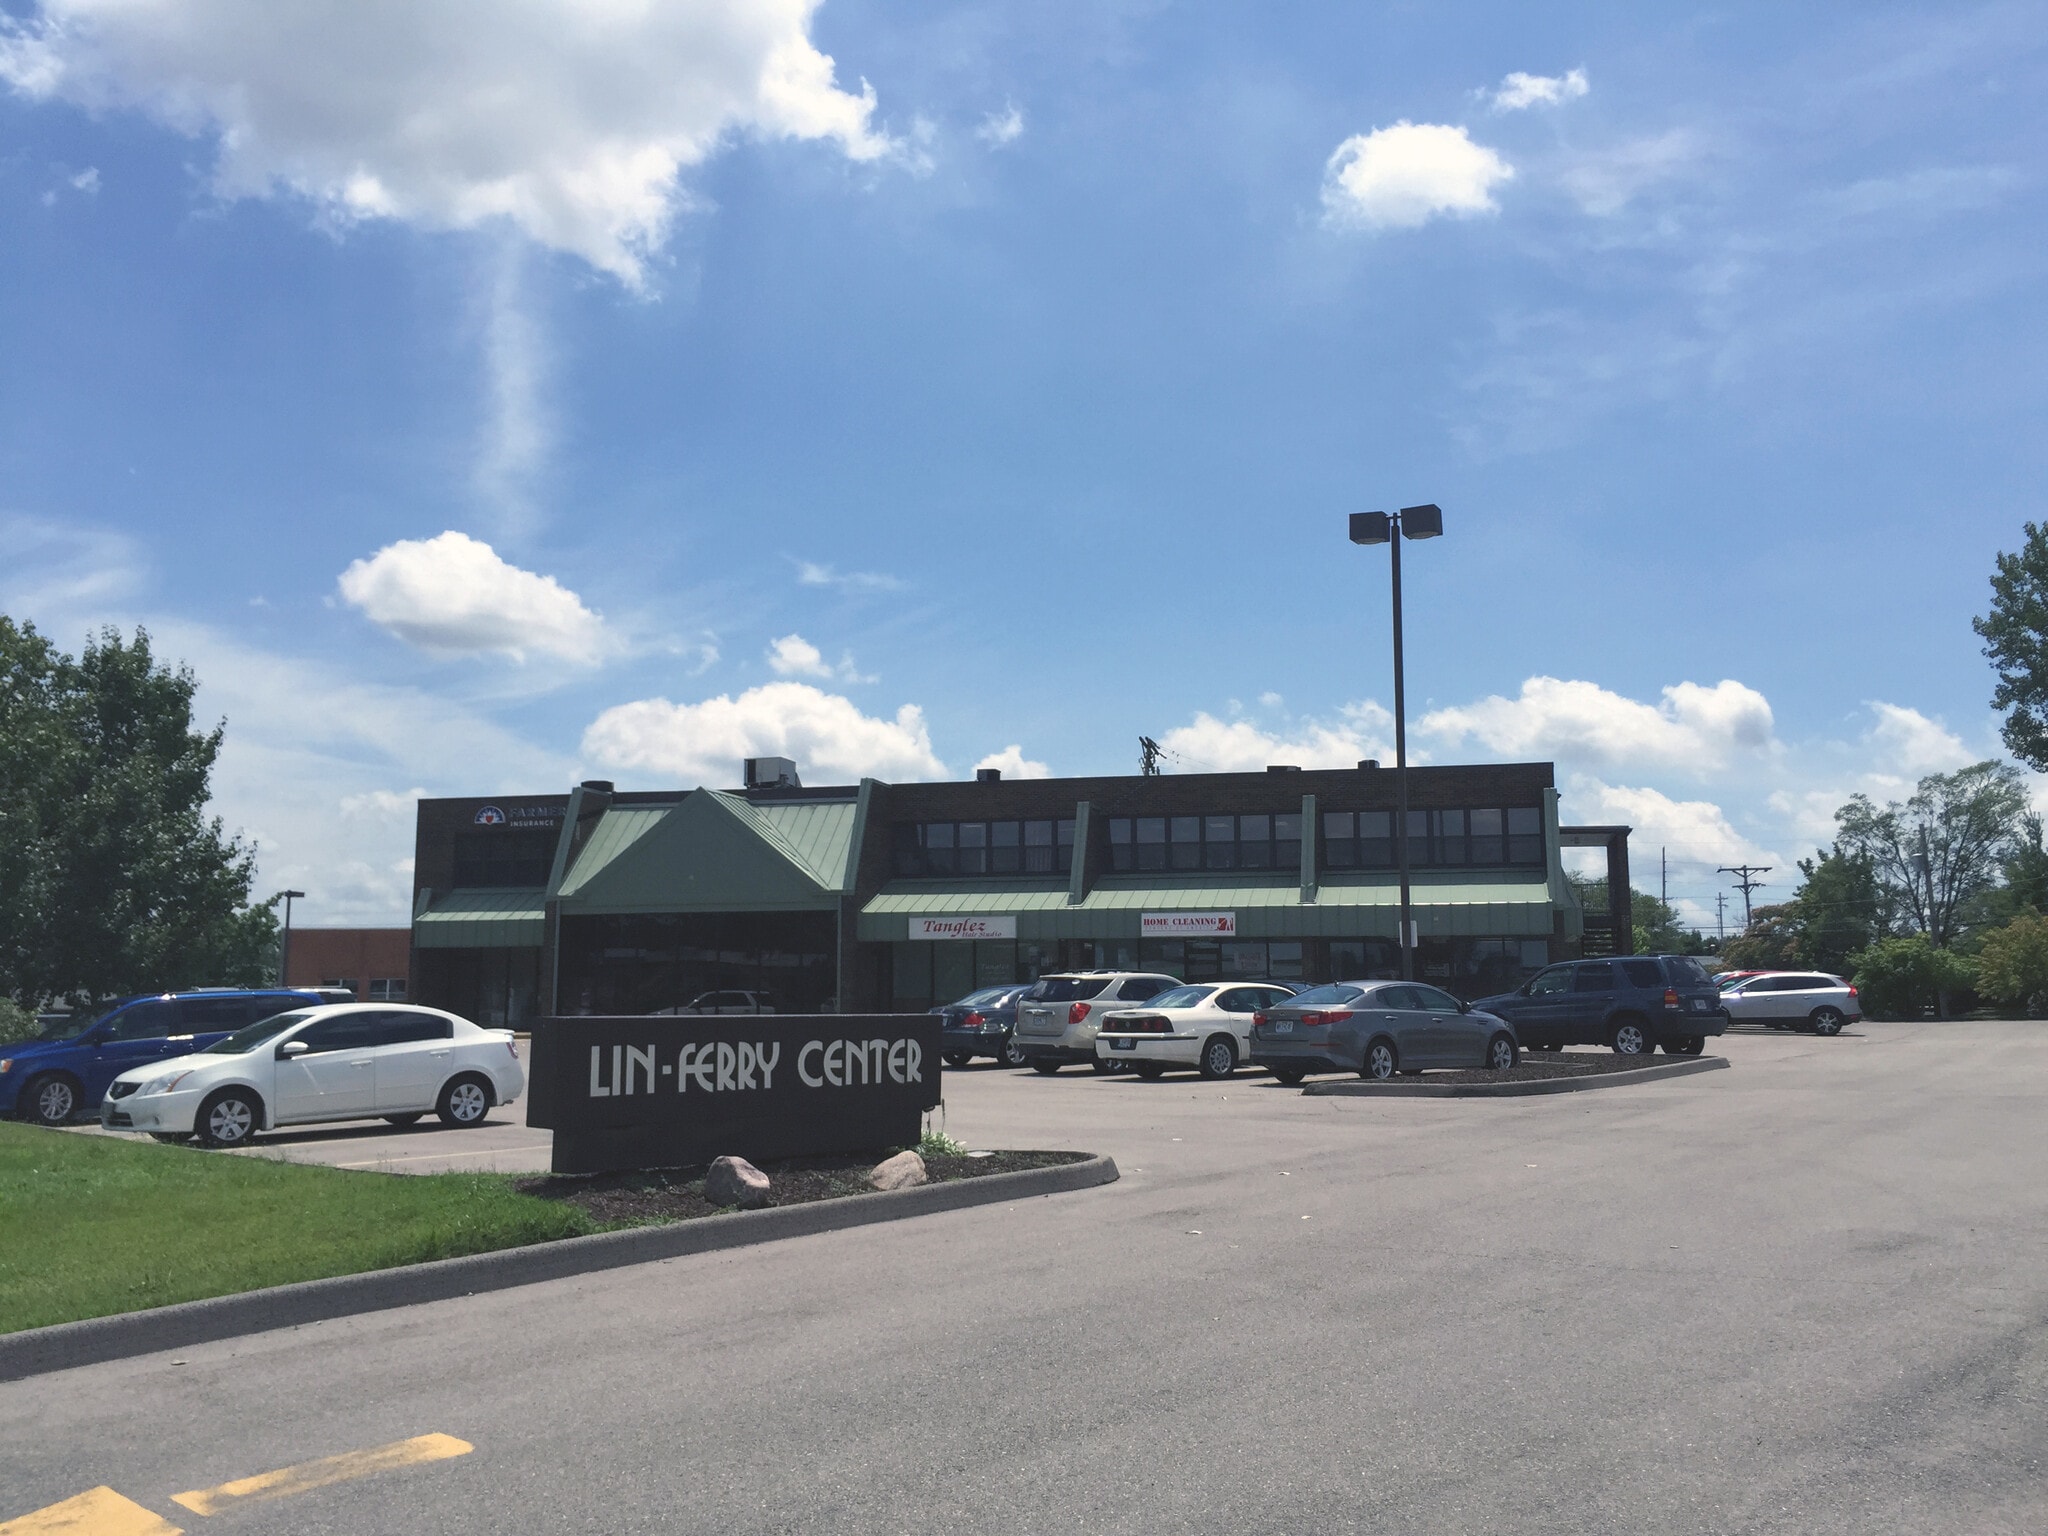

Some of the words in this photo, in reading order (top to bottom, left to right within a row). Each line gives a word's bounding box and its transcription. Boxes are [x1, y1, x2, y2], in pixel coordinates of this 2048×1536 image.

[509, 806, 567, 817] FARMER
[510, 819, 554, 827] INSURANCE
[1143, 917, 1169, 926] HOME
[1172, 917, 1217, 926] CLEANING
[923, 918, 986, 938] Tanglez
[589, 1041, 781, 1098] LIN-FERRY
[797, 1038, 923, 1088] CENTER
